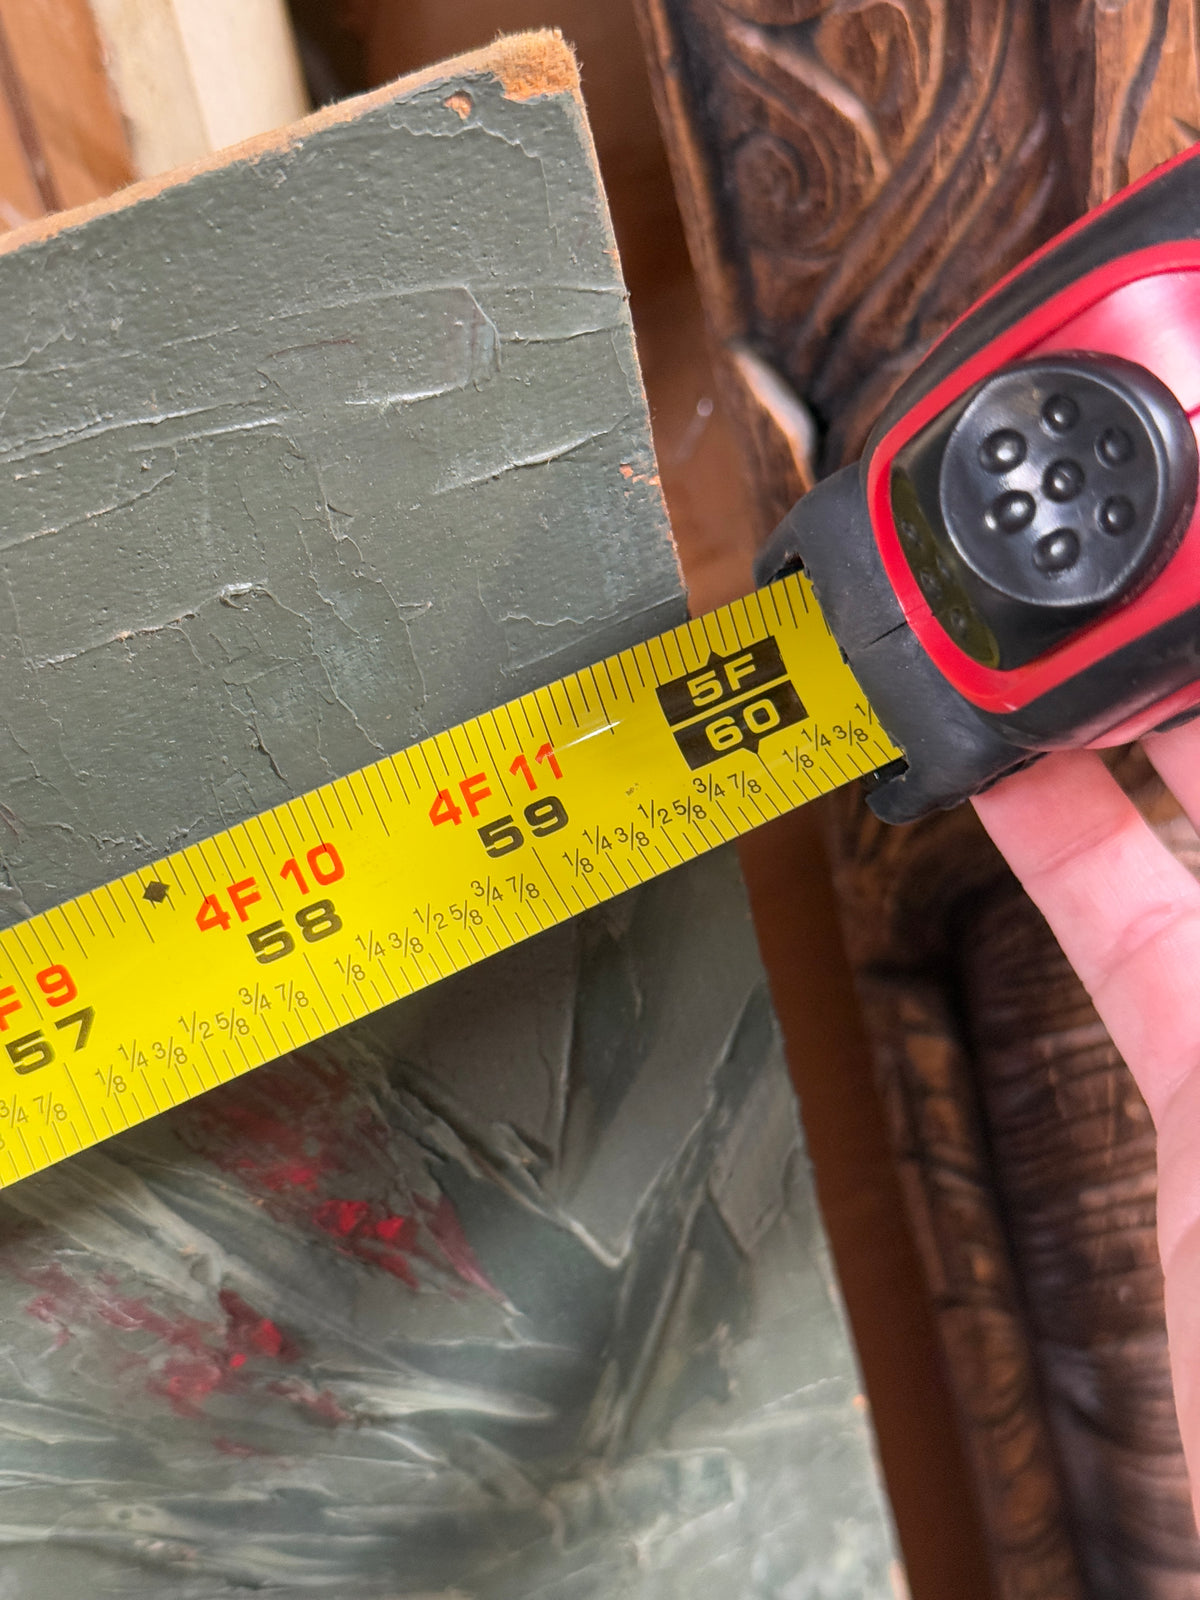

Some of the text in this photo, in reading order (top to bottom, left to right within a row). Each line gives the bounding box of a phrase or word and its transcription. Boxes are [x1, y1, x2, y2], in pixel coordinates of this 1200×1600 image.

[687, 653, 756, 707] 5F
[705, 698, 780, 751] 60
[782, 746, 814, 772] 1/8
[801, 724, 831, 751] 1/4
[832, 720, 868, 746] 3/8
[428, 742, 563, 827] 4F 11
[477, 796, 569, 858] 59
[562, 771, 762, 877] 1/8 1/4 3/8 1/2 5/8 3/4 7/8
[195, 842, 345, 932] 4F 10
[247, 899, 343, 964] 58
[334, 874, 540, 985] 1/8 1/4 3/8 1/2 5/8 3/4 7/8
[0, 964, 78, 1031] F 9
[5, 1006, 95, 1075] 57
[95, 980, 309, 1097] 1/8 1/4 3/8 1/2 5/8 3/4 7/8
[33, 1092, 67, 1125] 7/8
